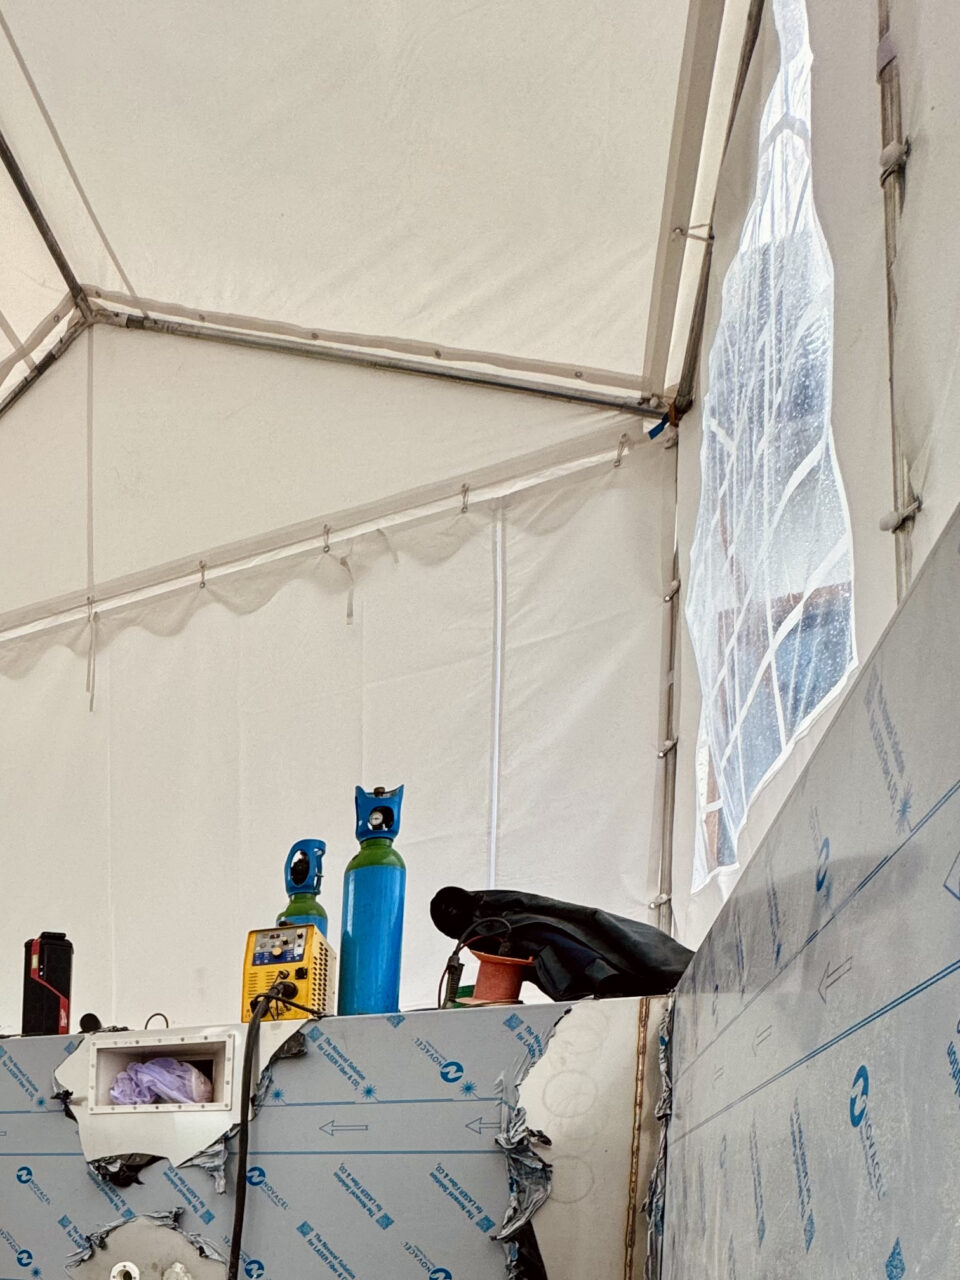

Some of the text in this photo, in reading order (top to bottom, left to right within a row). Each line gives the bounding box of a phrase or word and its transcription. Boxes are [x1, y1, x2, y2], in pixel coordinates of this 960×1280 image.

[322, 1049, 339, 1066] LASER
[330, 1044, 350, 1063] Novacel
[346, 1061, 365, 1081] Solution
[414, 1037, 446, 1068] NOVACEL
[262, 1177, 288, 1210] NOVACEL
[402, 1241, 435, 1275] NOVACEL
